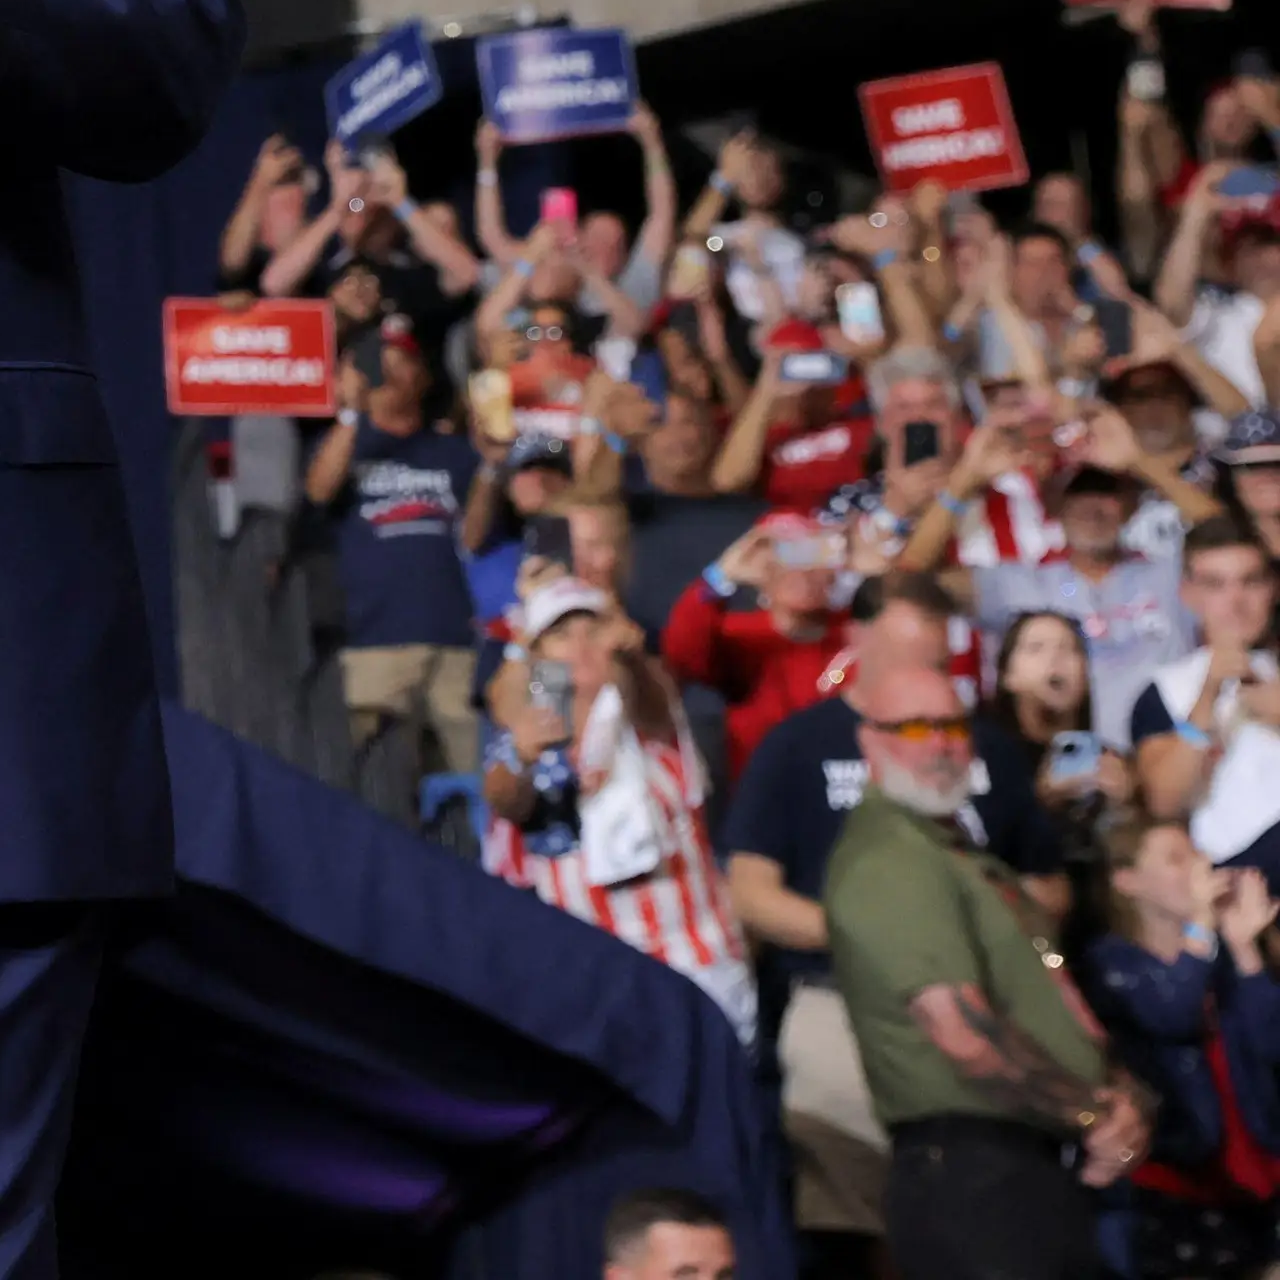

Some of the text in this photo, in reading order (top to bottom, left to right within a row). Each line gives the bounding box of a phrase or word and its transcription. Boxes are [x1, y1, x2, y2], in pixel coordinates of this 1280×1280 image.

[892, 98, 964, 137] SAVE
[213, 325, 290, 354] SAVE
[182, 355, 324, 386] AMERICA!
